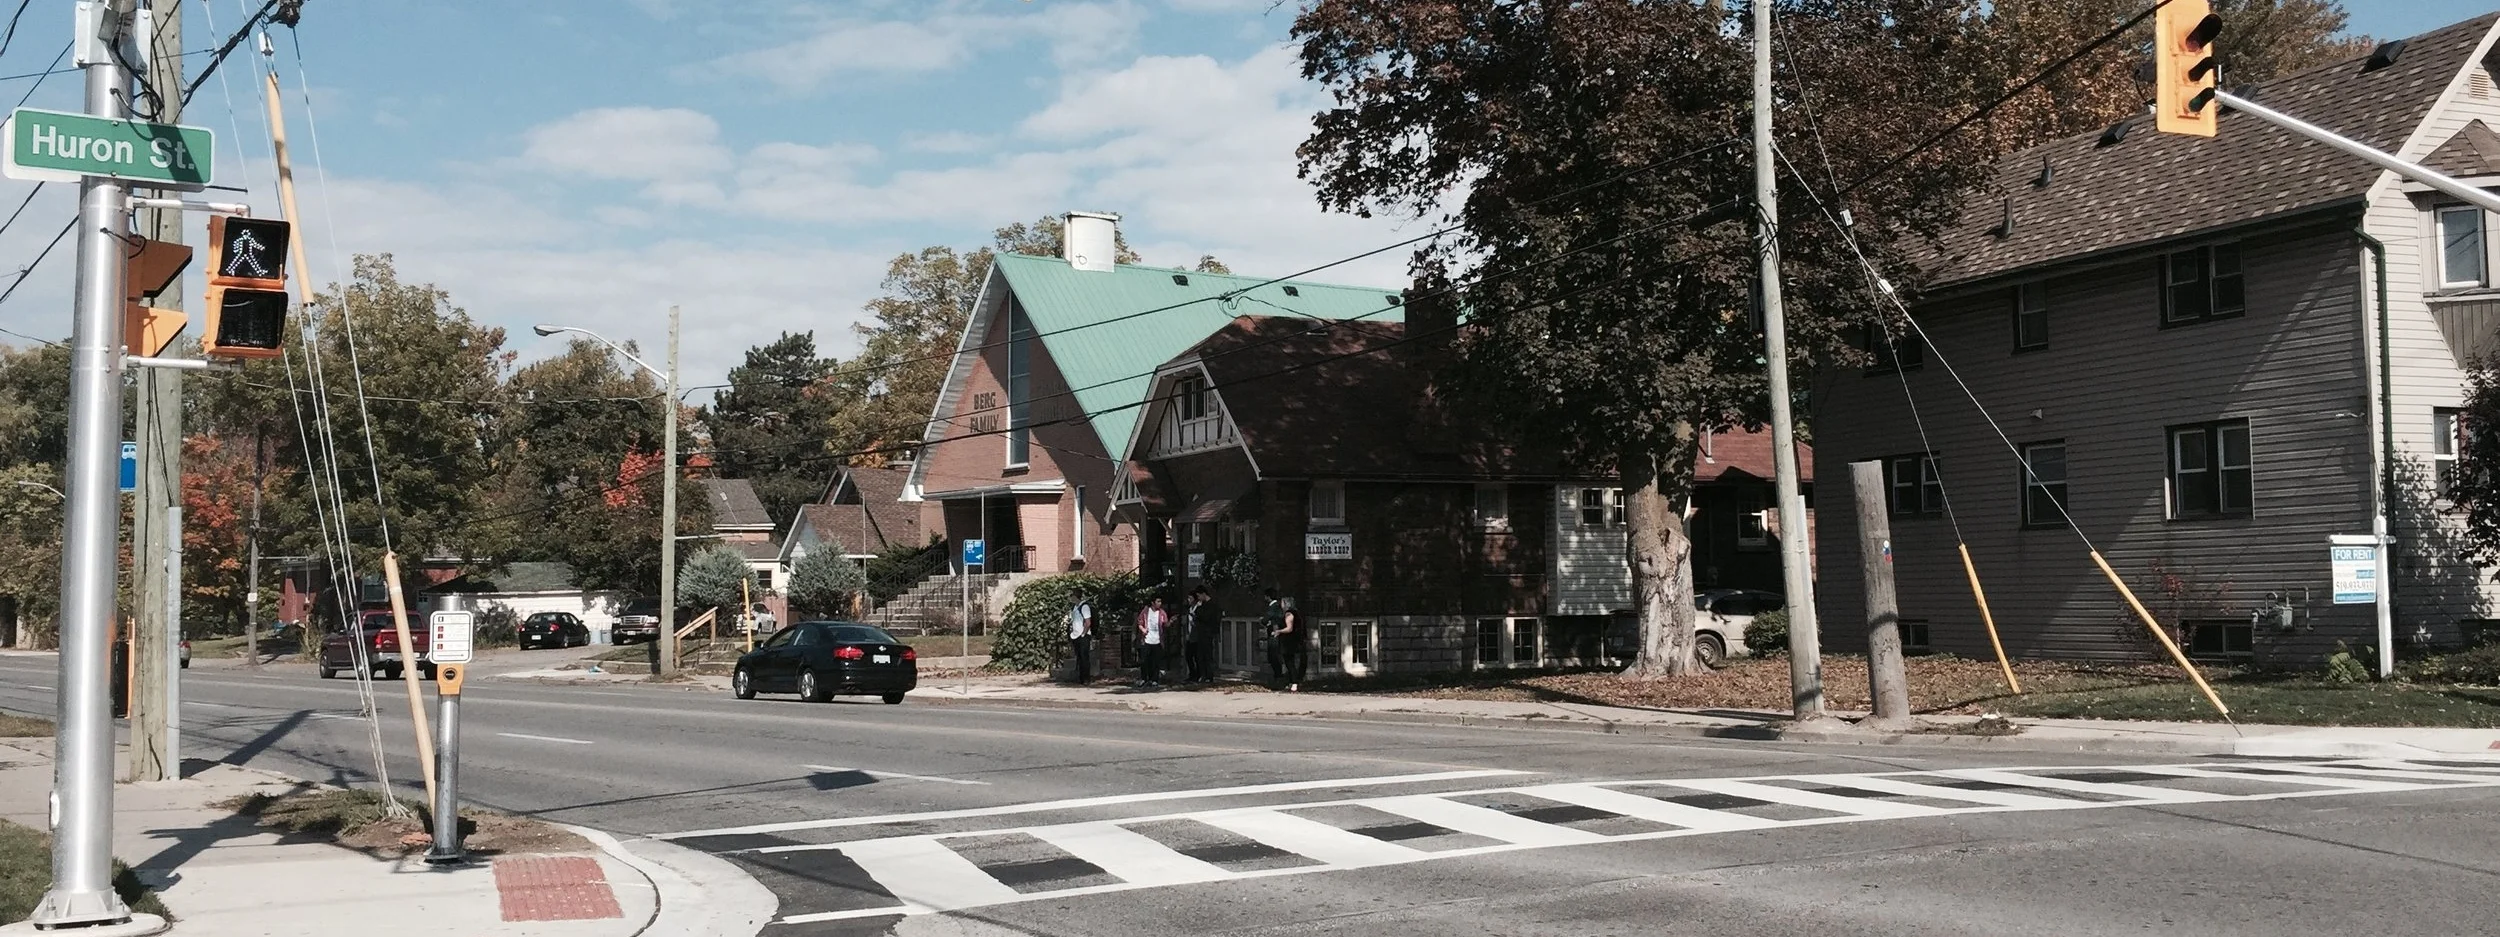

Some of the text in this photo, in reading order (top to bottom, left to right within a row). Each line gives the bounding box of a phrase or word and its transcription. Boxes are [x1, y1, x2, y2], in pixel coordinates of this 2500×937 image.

[32, 123, 195, 170] Huron St.
[973, 391, 997, 410] BERG
[969, 414, 1000, 433] FAMILY
[1312, 536, 1346, 547] Taylor's
[1308, 546, 1350, 555] BARBER SHOP
[2335, 549, 2373, 560] FOR RENT
